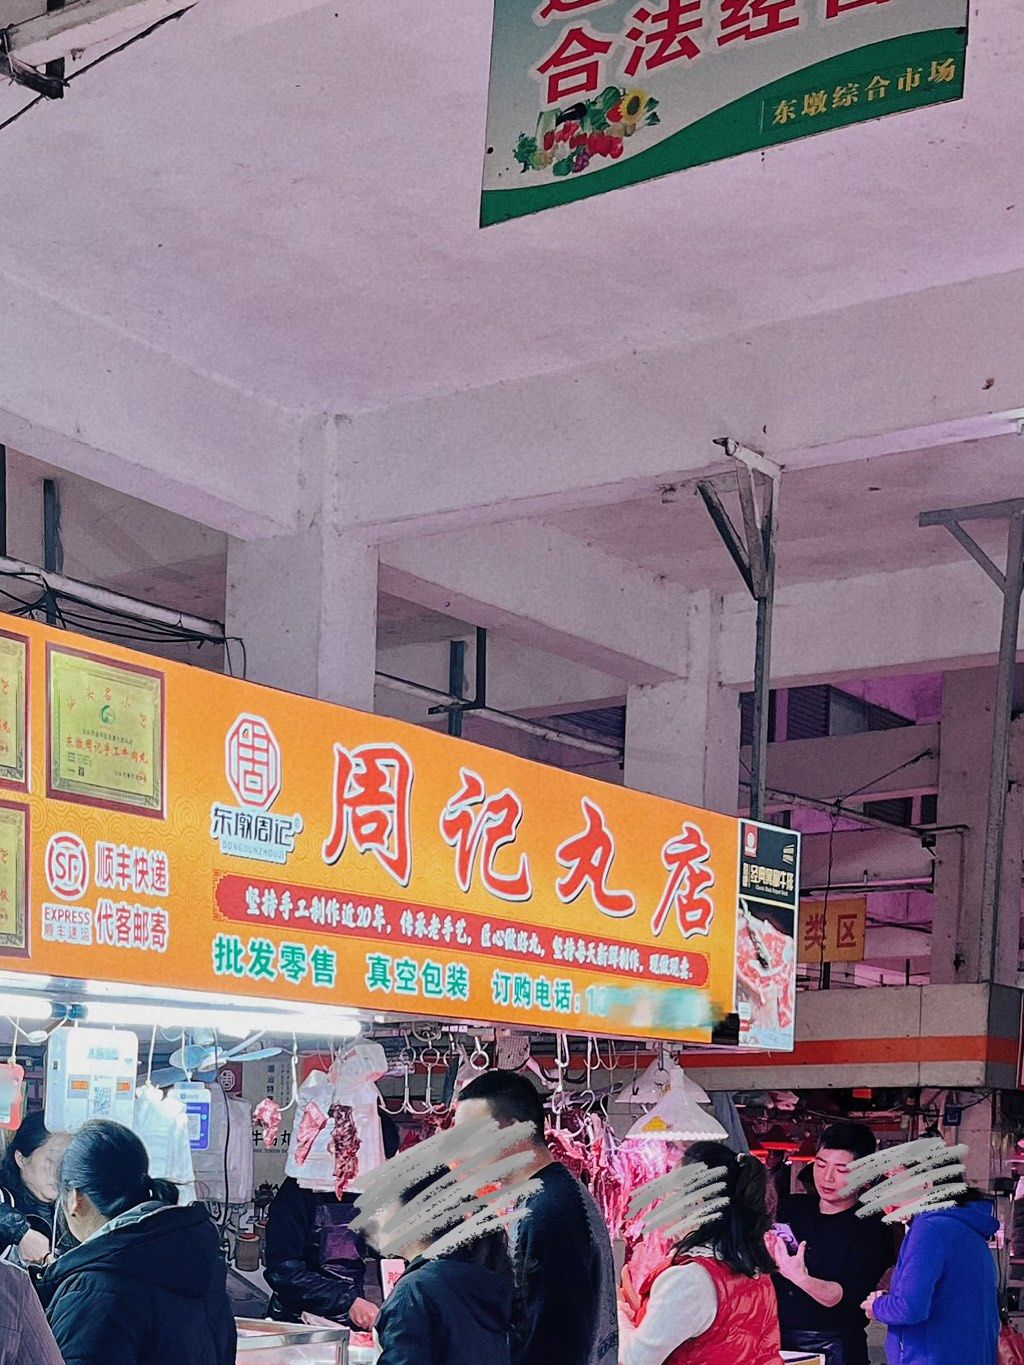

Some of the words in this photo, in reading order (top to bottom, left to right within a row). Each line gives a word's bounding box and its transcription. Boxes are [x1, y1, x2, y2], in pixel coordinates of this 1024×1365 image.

[537, 0, 891, 104] 合法经
[772, 58, 956, 125] 东墩综合市场
[213, 807, 293, 846] 东墩周记
[324, 743, 716, 938] 周记丸店
[97, 844, 167, 892] 顺丰快递
[44, 907, 90, 925] EXPRESS
[97, 902, 166, 949] 代客邮寄
[804, 913, 858, 950] 类区
[214, 936, 336, 986] 批发零售
[367, 953, 468, 1000] 真空包装
[252, 1129, 292, 1147] 牛丸
